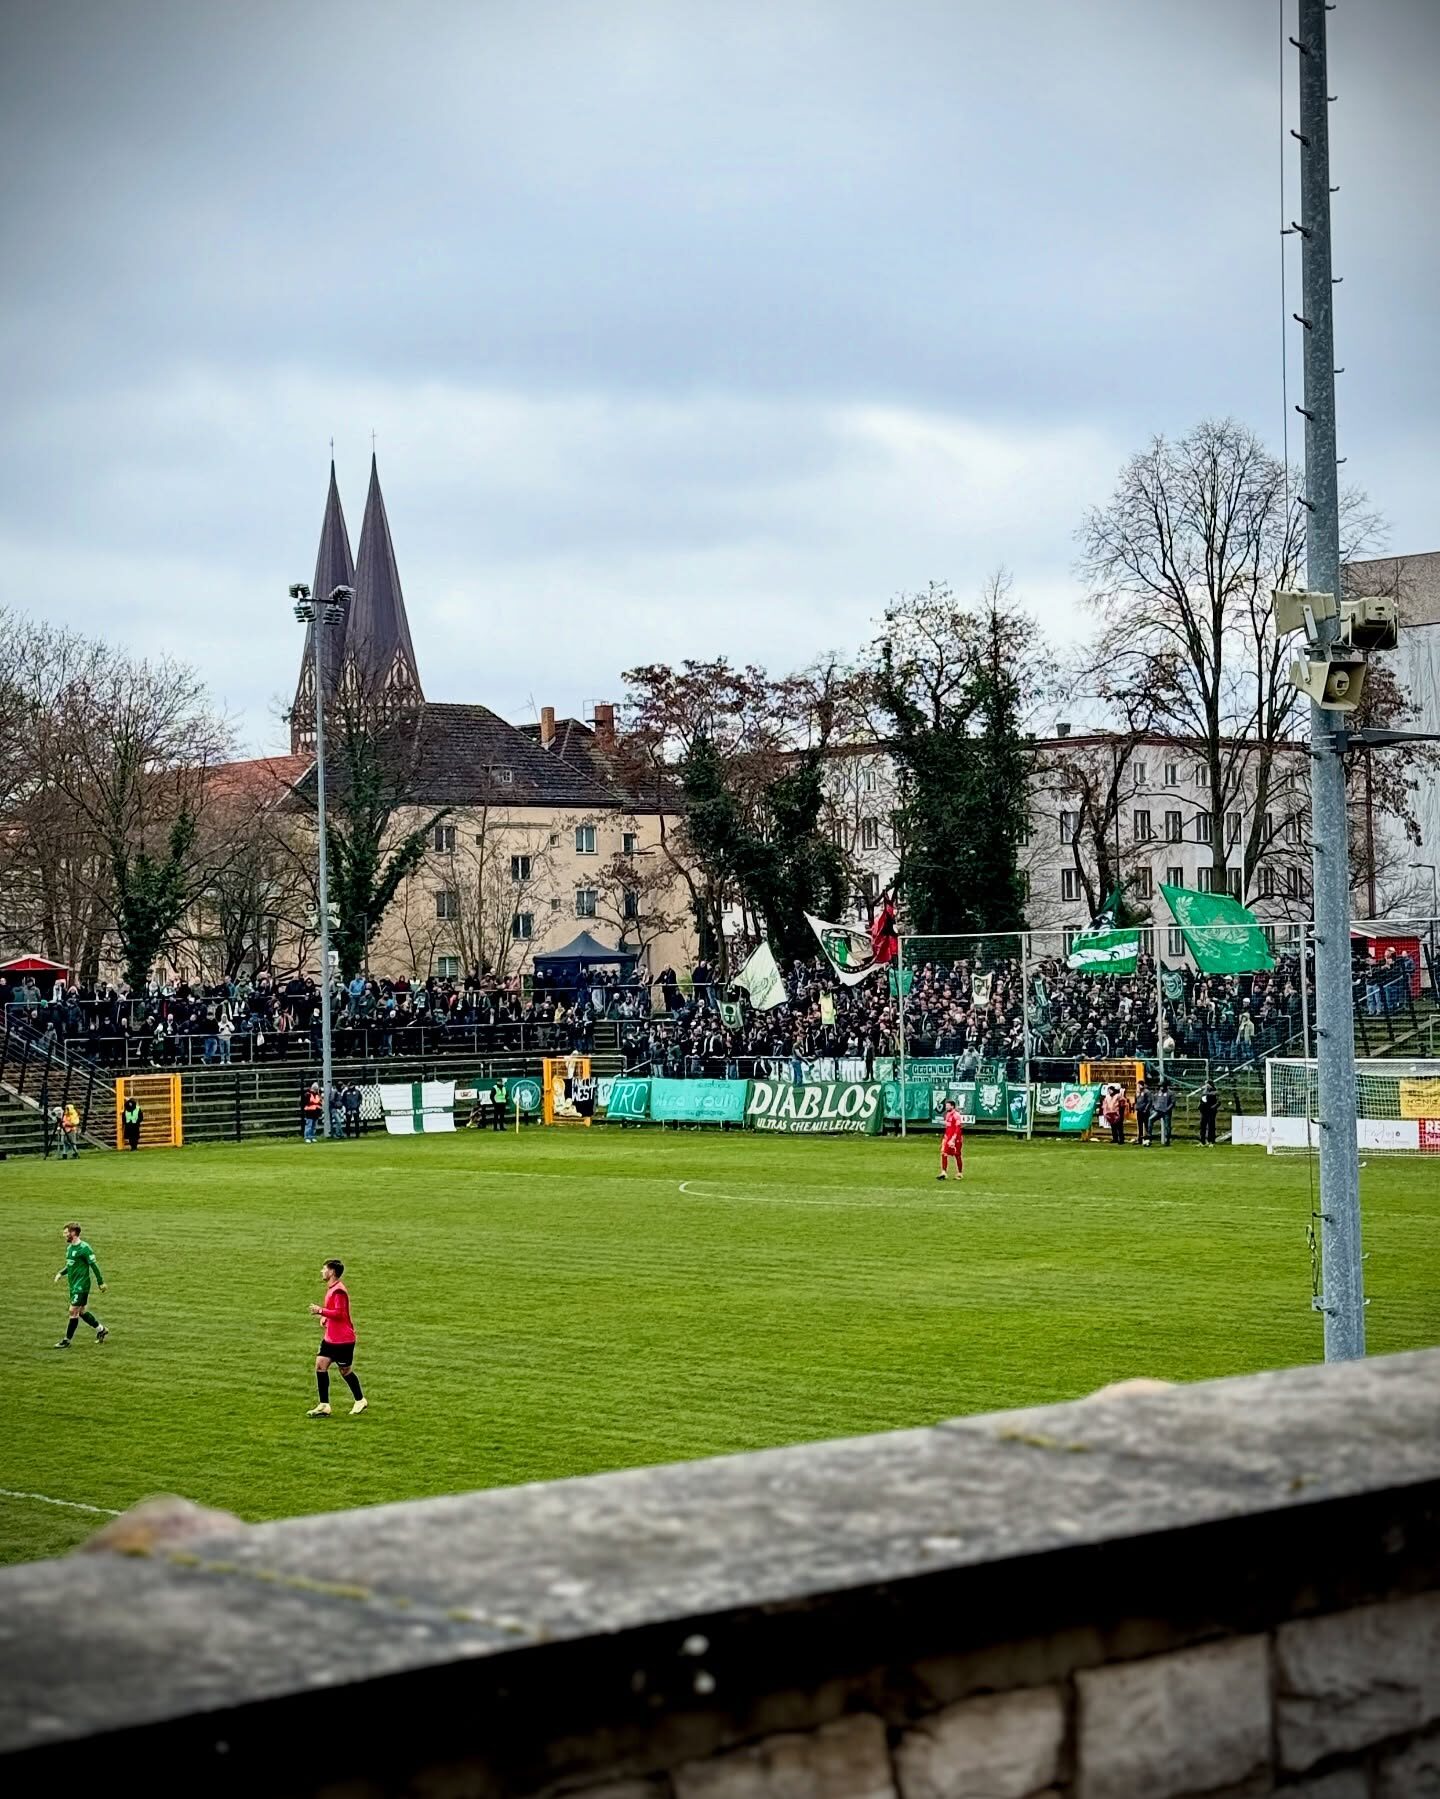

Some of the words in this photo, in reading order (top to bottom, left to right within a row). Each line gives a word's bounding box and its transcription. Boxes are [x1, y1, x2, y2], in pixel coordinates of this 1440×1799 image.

[572, 1086, 596, 1102] WEST
[610, 1083, 648, 1113] TRC
[746, 1082, 881, 1119] DIABLOS
[756, 1117, 788, 1130] ULTRAS
[790, 1120, 828, 1132] CHEMIE
[829, 1119, 866, 1131] LEIPZIG
